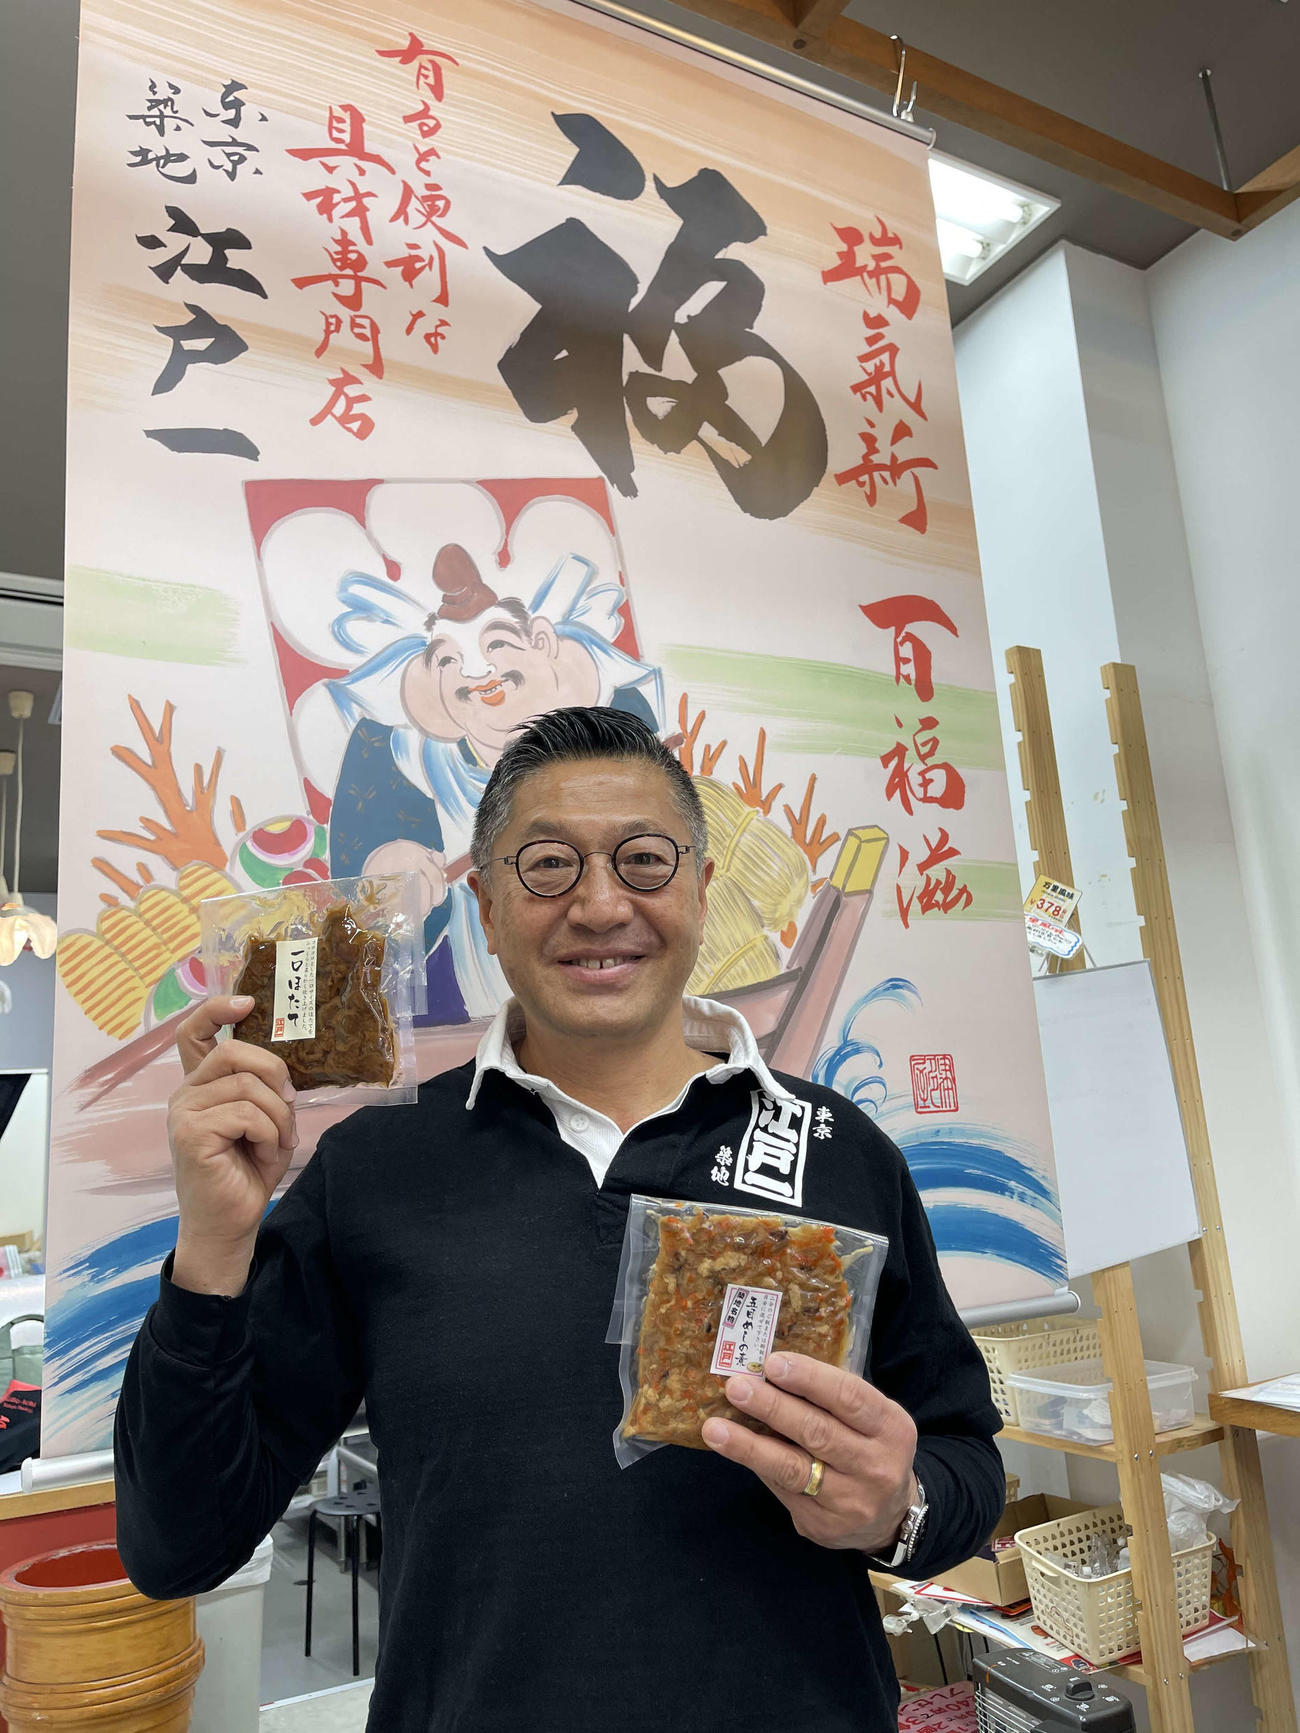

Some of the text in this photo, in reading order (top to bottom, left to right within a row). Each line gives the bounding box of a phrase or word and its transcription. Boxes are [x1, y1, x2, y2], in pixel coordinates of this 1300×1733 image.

[126, 78, 198, 185] 築地
[200, 79, 269, 182] 東京
[375, 32, 468, 355] 有ると便利な
[285, 104, 396, 441] 具材専門店
[483, 111, 829, 521] 福
[134, 205, 269, 462] 江戸一
[287, 950, 305, 1028] 一口ほたて
[710, 1145, 733, 1186] 築地
[744, 1092, 803, 1197] 江戸一
[812, 1105, 835, 1140] 東京
[735, 1296, 758, 1367] 五目めしの素
